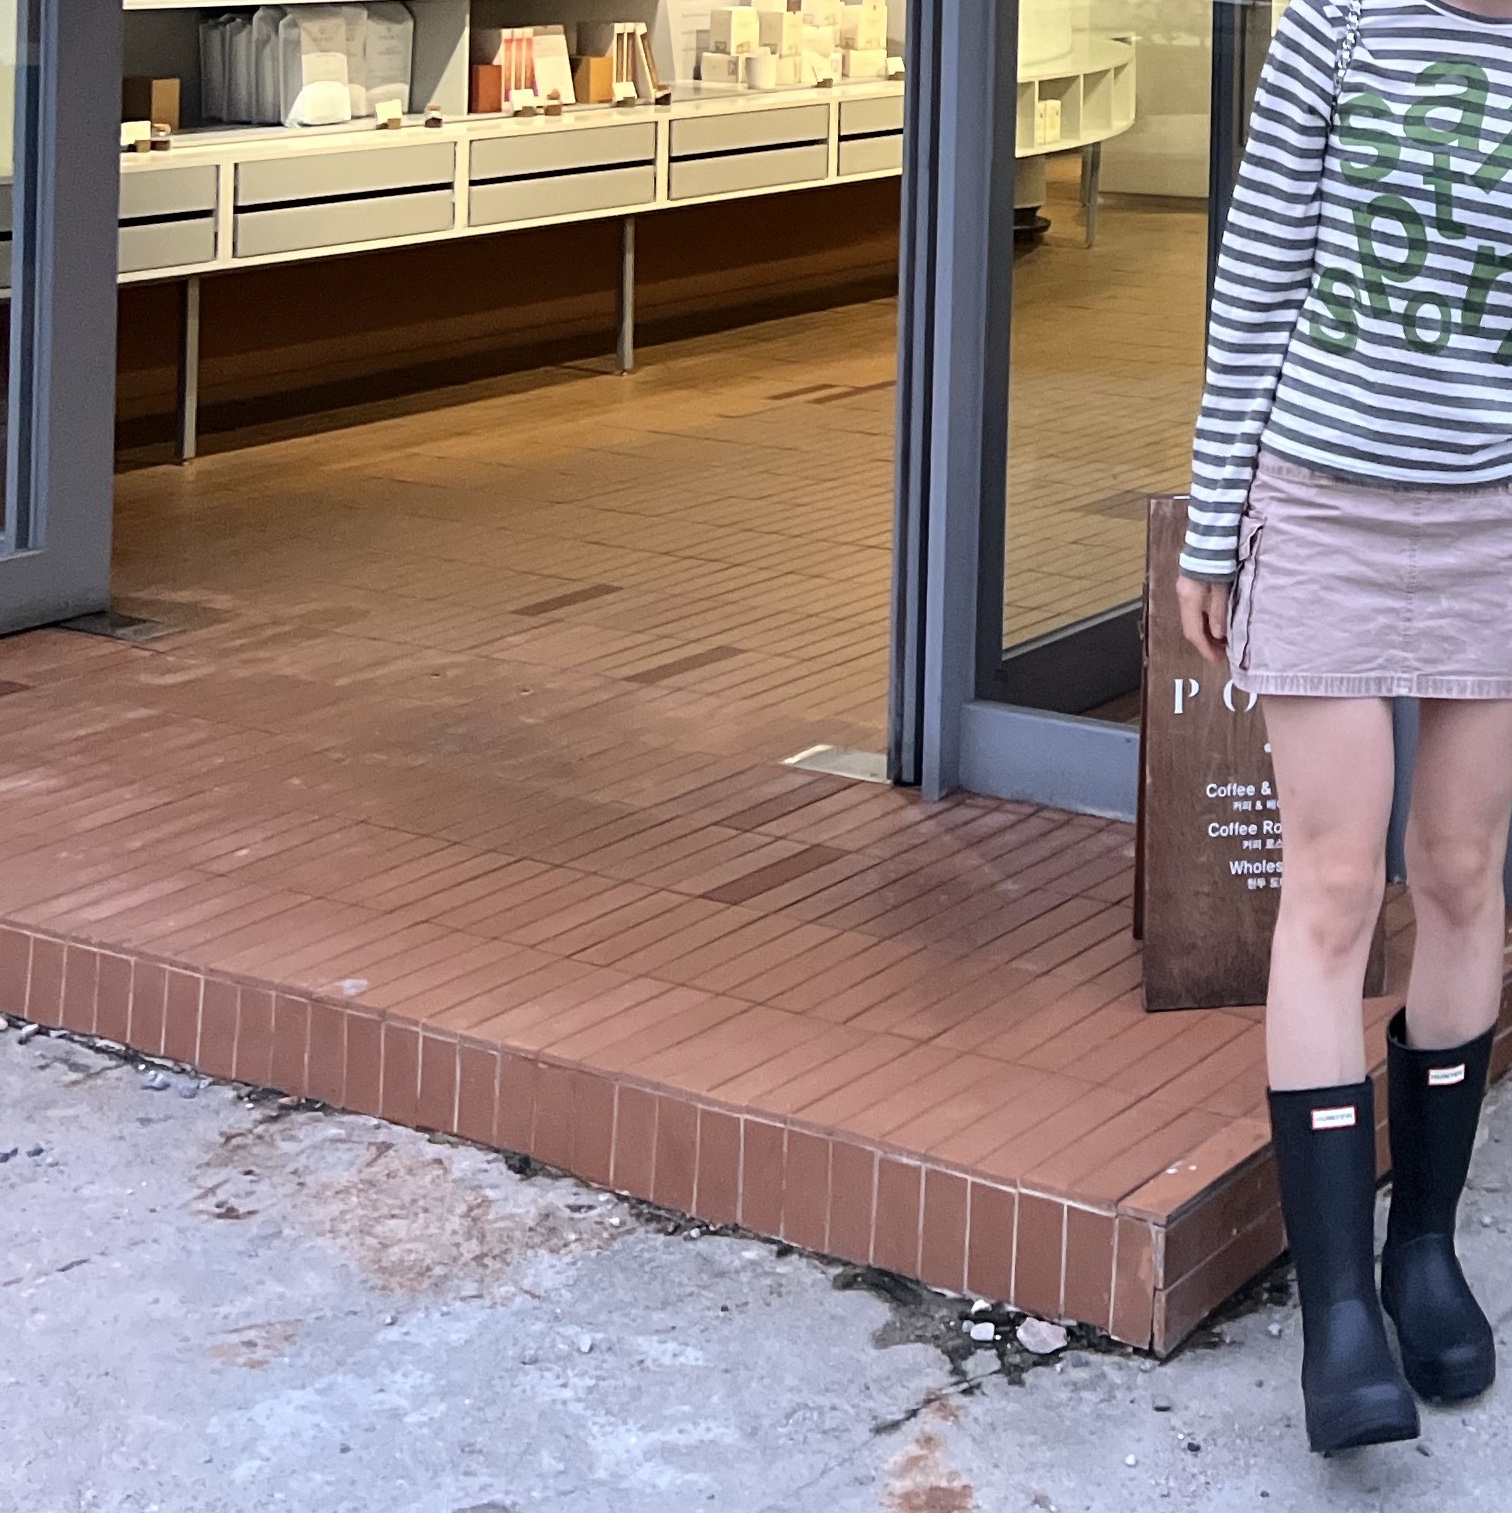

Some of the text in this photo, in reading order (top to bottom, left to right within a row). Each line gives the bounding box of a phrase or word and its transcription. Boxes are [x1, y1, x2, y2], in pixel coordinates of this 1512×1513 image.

[1206, 781, 1272, 798] Coffee &
[1208, 821, 1258, 838] Coffee
